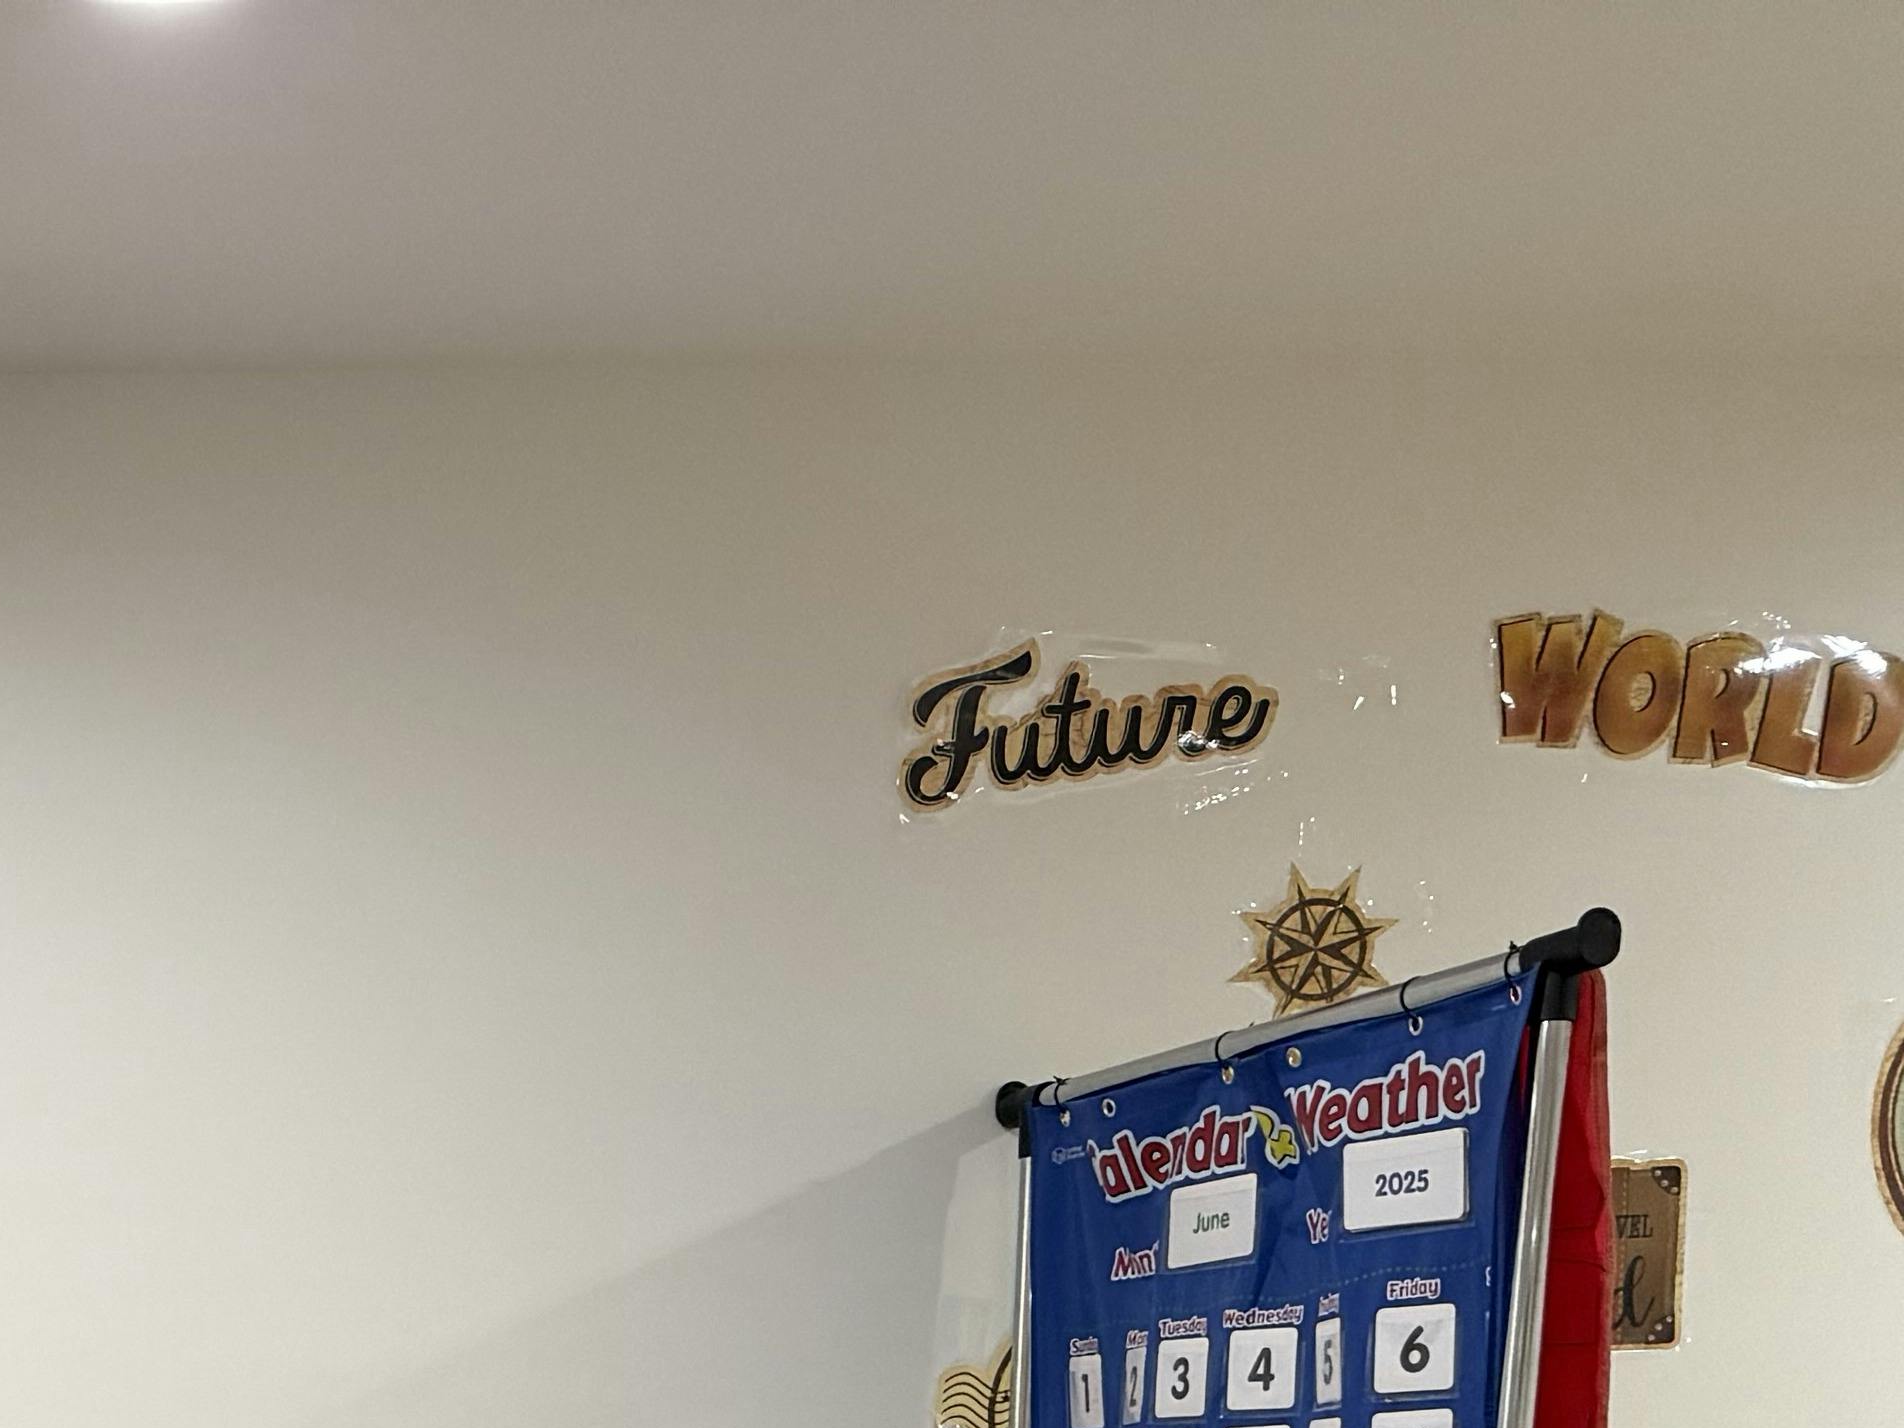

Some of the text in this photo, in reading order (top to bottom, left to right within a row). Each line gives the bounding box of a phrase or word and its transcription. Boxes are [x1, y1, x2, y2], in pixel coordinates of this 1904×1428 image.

[1497, 613, 1904, 781] WORLD
[903, 647, 1272, 805] Future
[1286, 1049, 1485, 1155] Weather
[1375, 1169, 1429, 1197] 2025
[1192, 1212, 1230, 1234] June
[1387, 1278, 1441, 1301] Friday
[1158, 1317, 1207, 1338] Tuesday
[1222, 1305, 1303, 1328] Wednesday
[1399, 1325, 1430, 1374] 6
